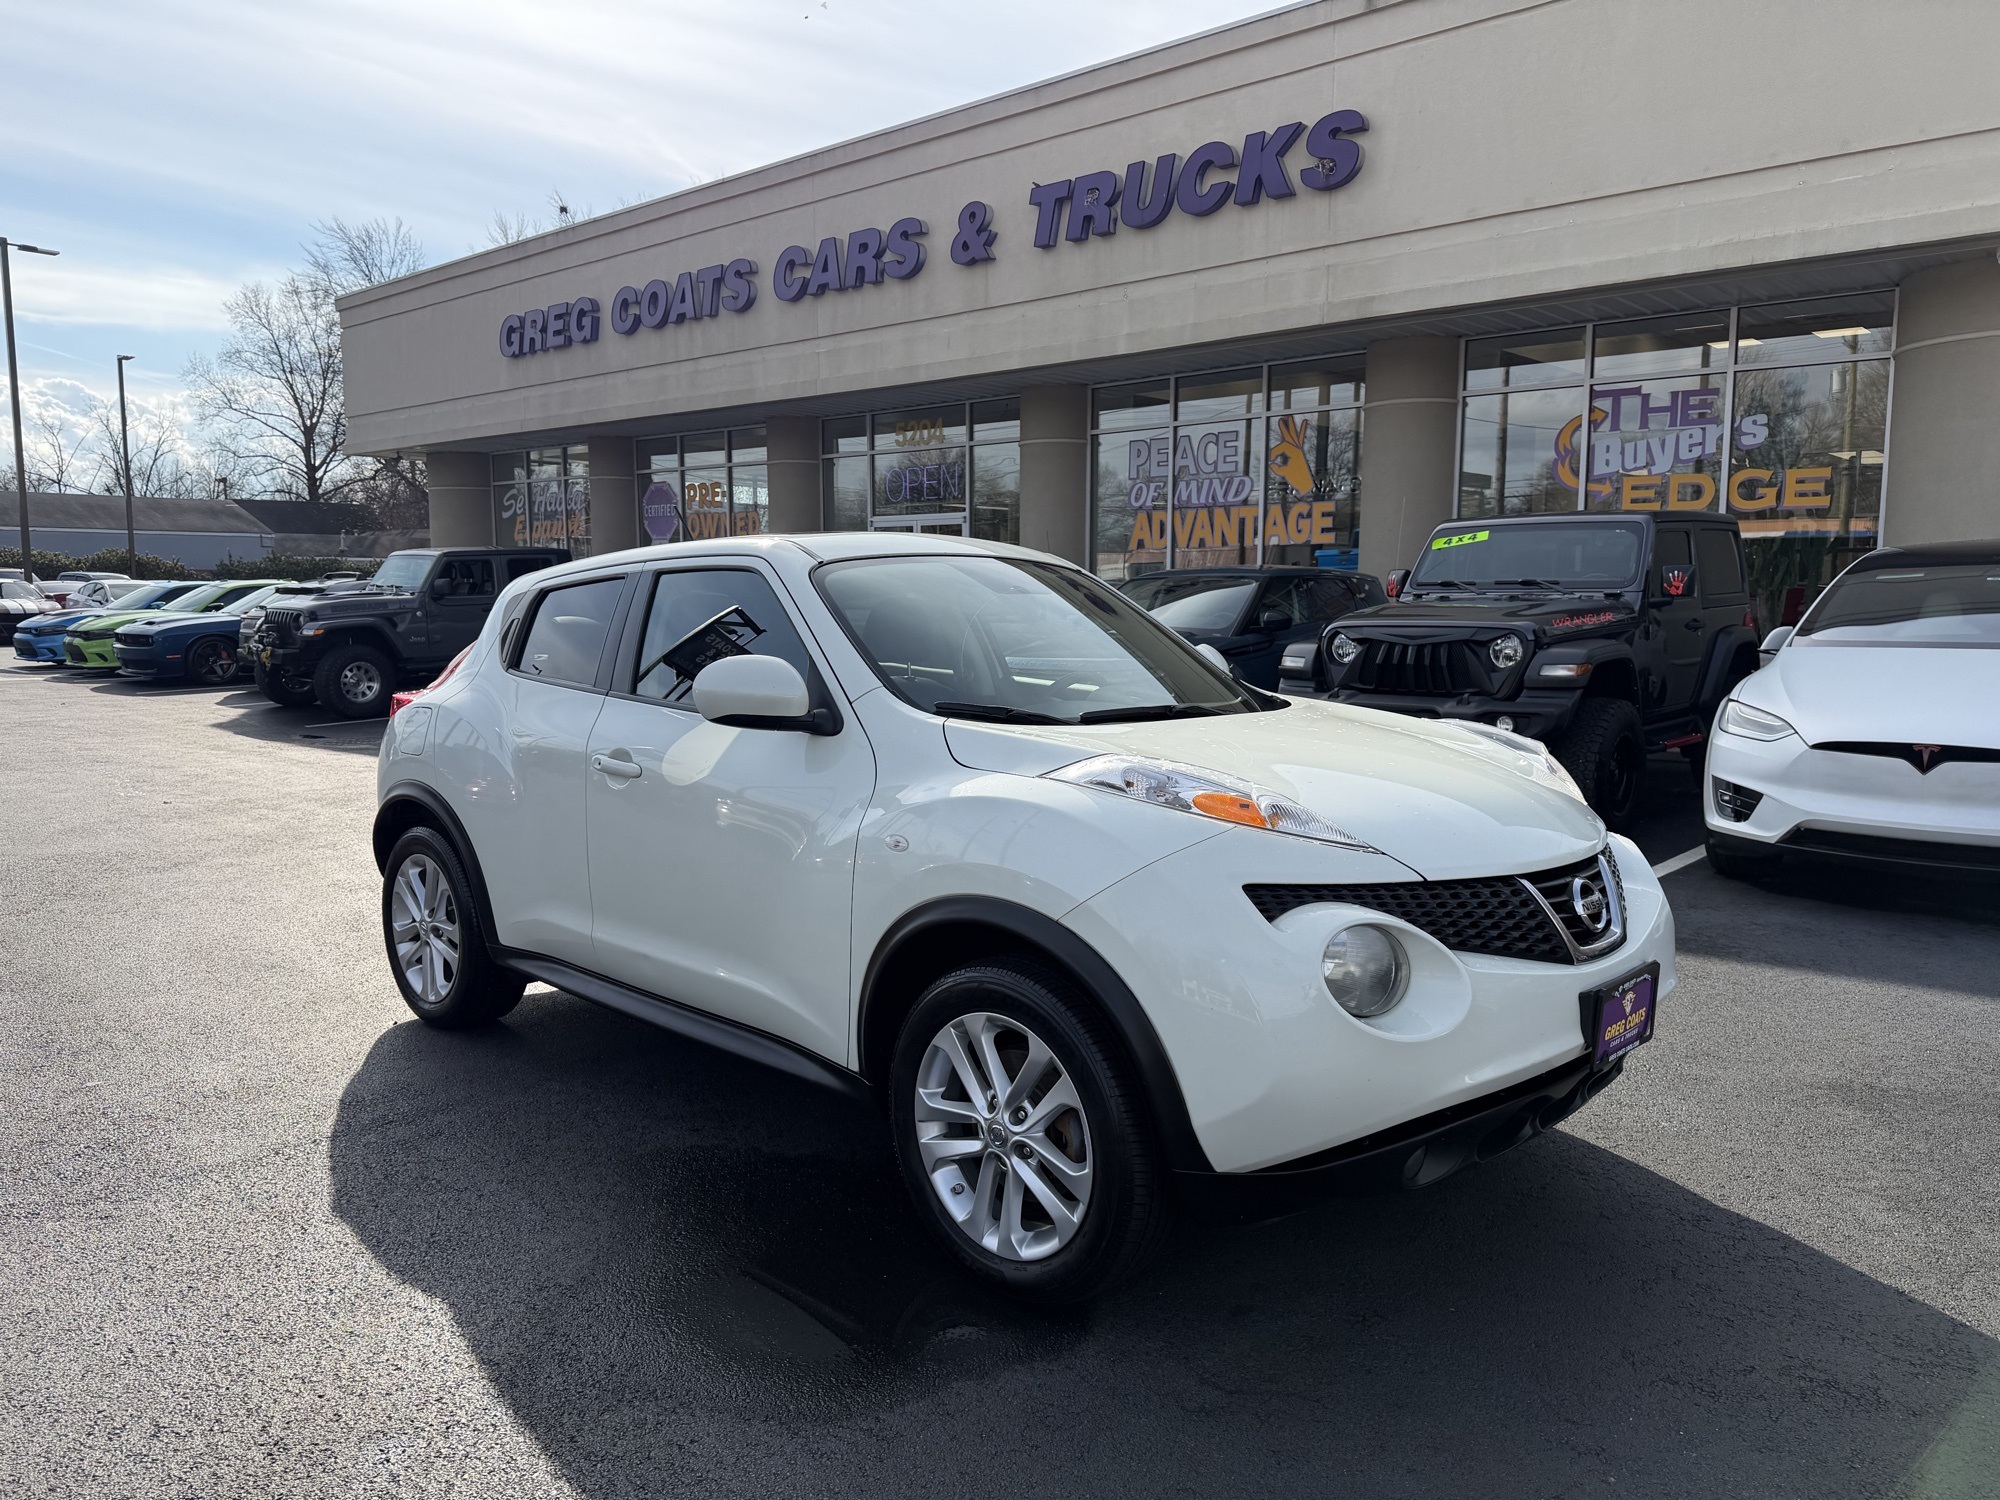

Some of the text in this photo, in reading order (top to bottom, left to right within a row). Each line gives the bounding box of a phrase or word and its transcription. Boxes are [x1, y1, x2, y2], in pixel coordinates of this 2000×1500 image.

[500, 109, 1369, 358] GREG COATS CARS & TRUCKS
[1592, 385, 1720, 432] THE
[895, 417, 945, 447] 5204
[1593, 413, 1769, 478] Buyer's
[1129, 430, 1239, 480] PEACE
[685, 482, 727, 510] PRE-
[886, 463, 959, 502] OPEN
[1128, 482, 1167, 509] OF
[1174, 475, 1254, 508] MIND
[1621, 466, 1832, 512] EDGE
[502, 488, 524, 519] Se
[644, 503, 676, 517] CERTIFIED
[687, 511, 760, 539] OWNED
[1128, 501, 1336, 551] ADVANTAGE
[1552, 612, 1617, 628] WRANGLER
[1605, 1007, 1646, 1040] GREG COATS
